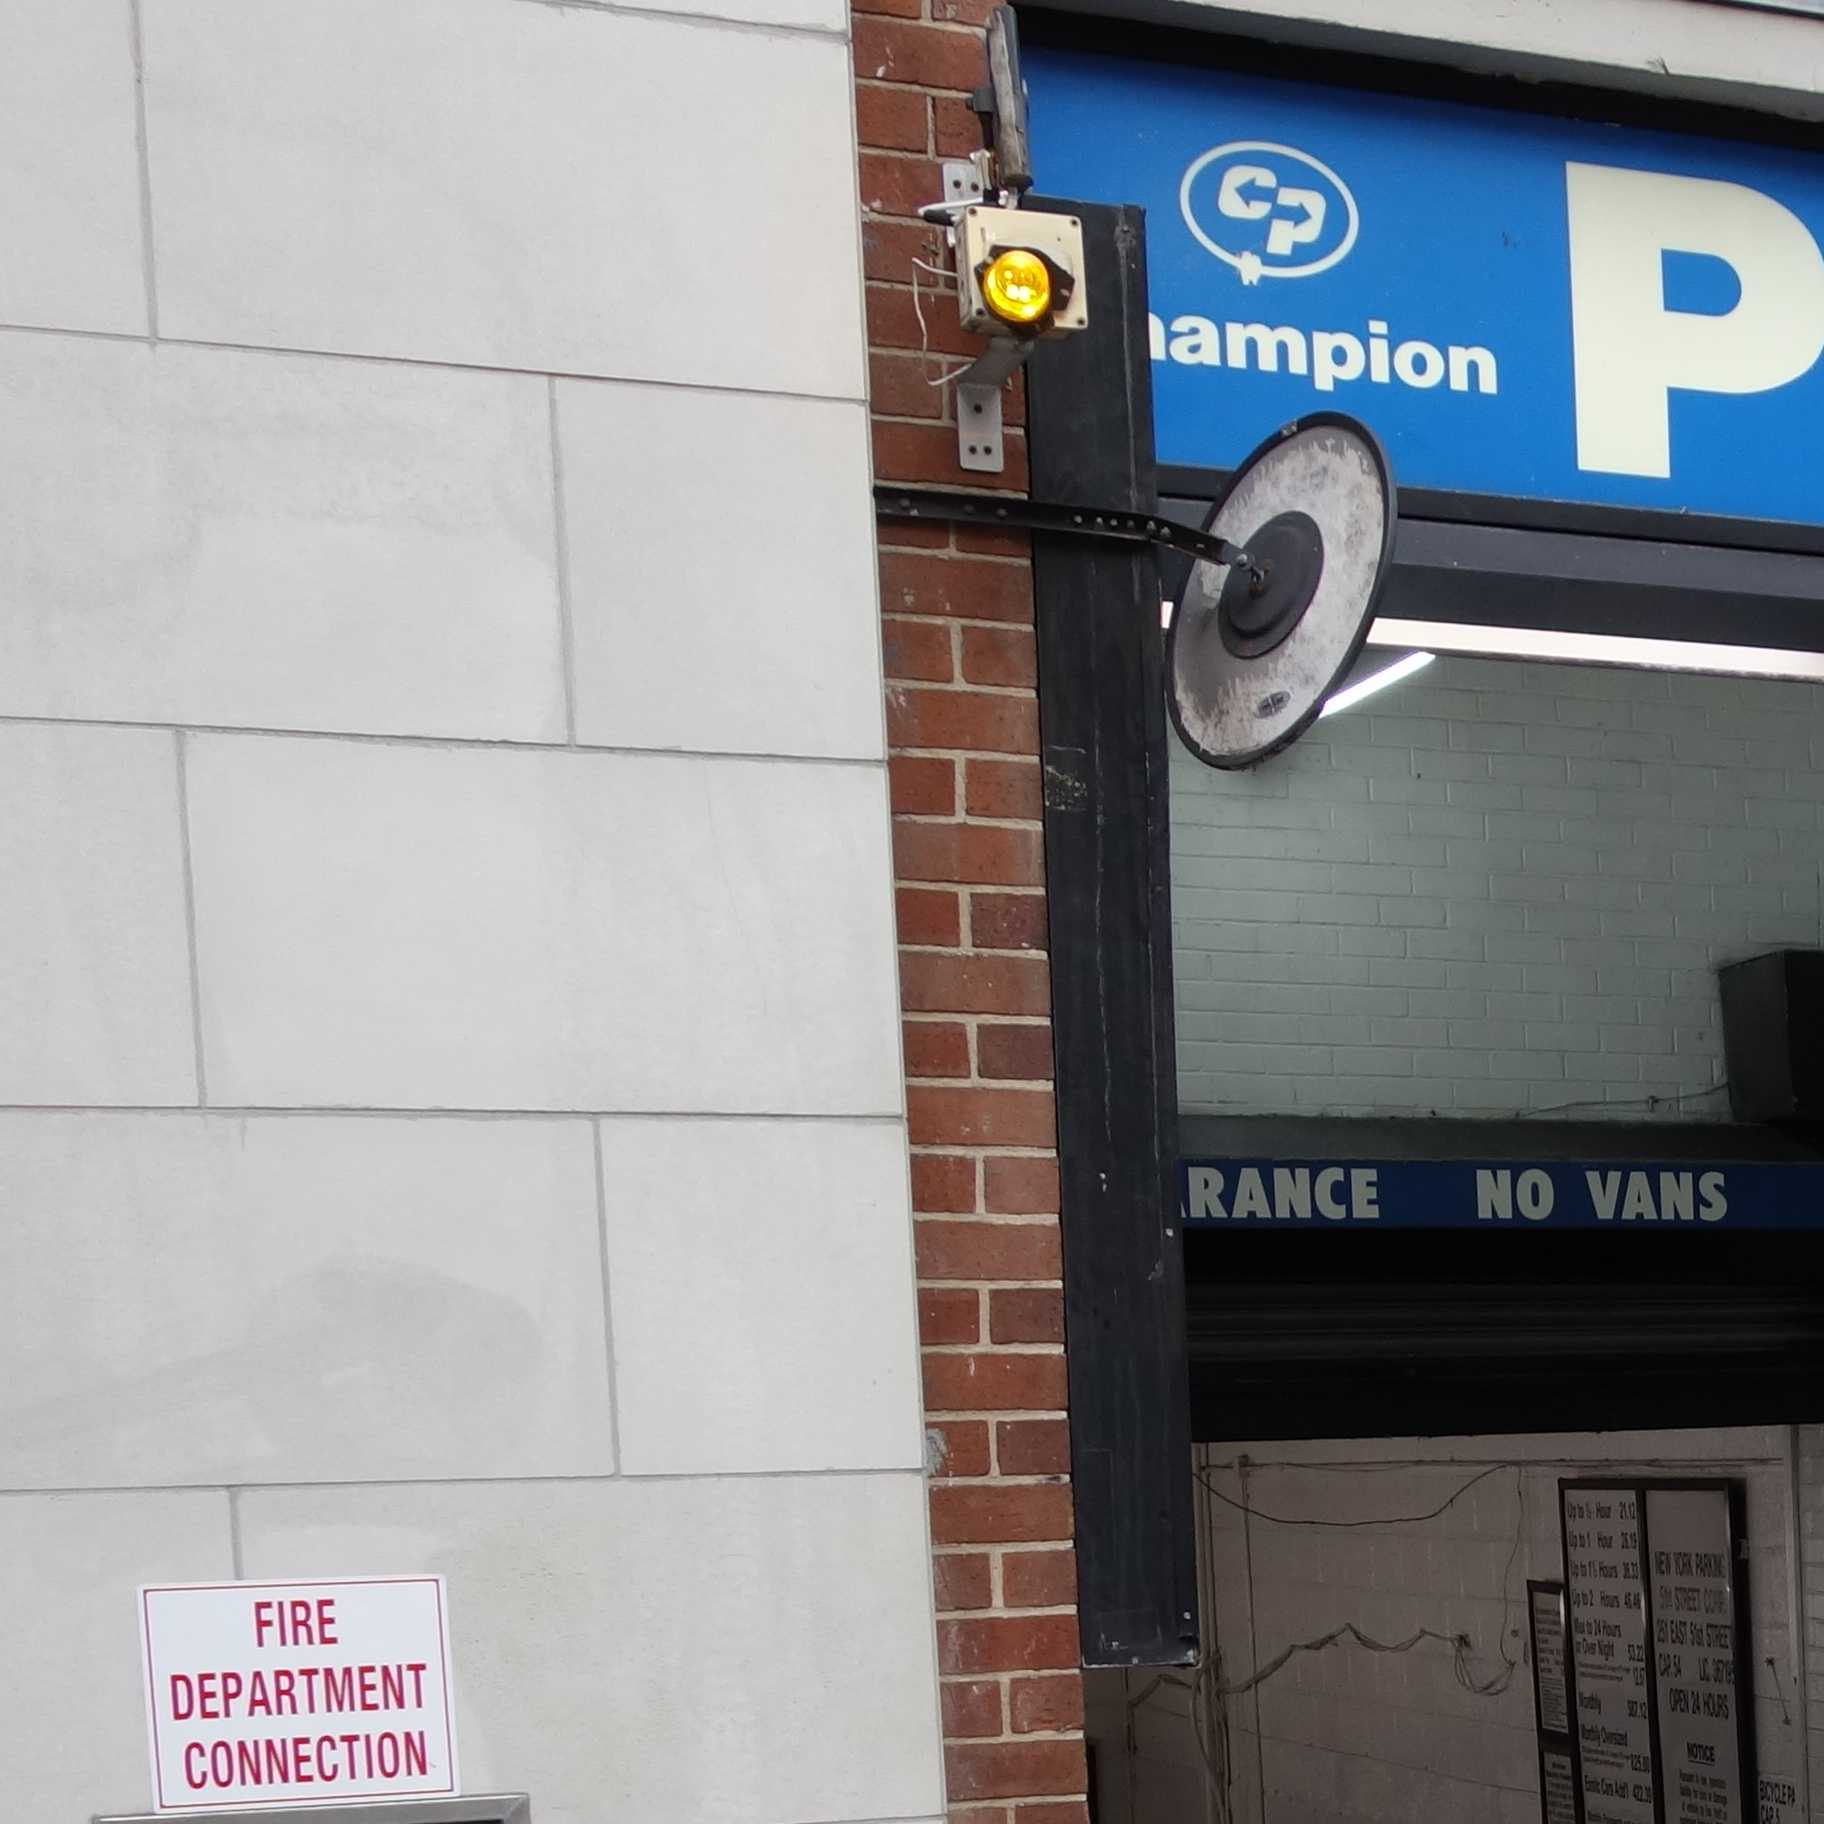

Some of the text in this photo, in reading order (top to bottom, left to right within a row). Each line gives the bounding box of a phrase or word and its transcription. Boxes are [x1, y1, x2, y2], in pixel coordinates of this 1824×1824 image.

[1181, 1166, 1728, 1223] RANCE NO VANS
[1568, 1502, 1576, 1521] Up
[1596, 1502, 1611, 1519] Hour
[1569, 1530, 1577, 1551] Up
[1597, 1531, 1613, 1550] Hour
[1570, 1560, 1579, 1579] Up
[1599, 1561, 1618, 1579] Hours
[1655, 1550, 1726, 1578] NEW YORK PARKING
[1571, 1589, 1580, 1608] Up
[1600, 1590, 1619, 1609] Hours
[1674, 1586, 1700, 1612] STREET
[253, 1598, 338, 1649] FIRE
[1593, 1618, 1601, 1636] 24
[1602, 1619, 1622, 1638] Hours
[1670, 1619, 1687, 1645] EAST
[1706, 1622, 1732, 1648] STREET
[1583, 1638, 1596, 1655] Over
[1597, 1639, 1614, 1662] Night
[1673, 1653, 1681, 1678] 54
[170, 1663, 428, 1721] DEPARTMENT
[1669, 1687, 1728, 1719] OPEN 24 HOURS
[183, 1730, 430, 1790] CONNECTION
[1687, 1741, 1715, 1763] NOTICE
[1760, 1780, 1786, 1806] BICYCLE
